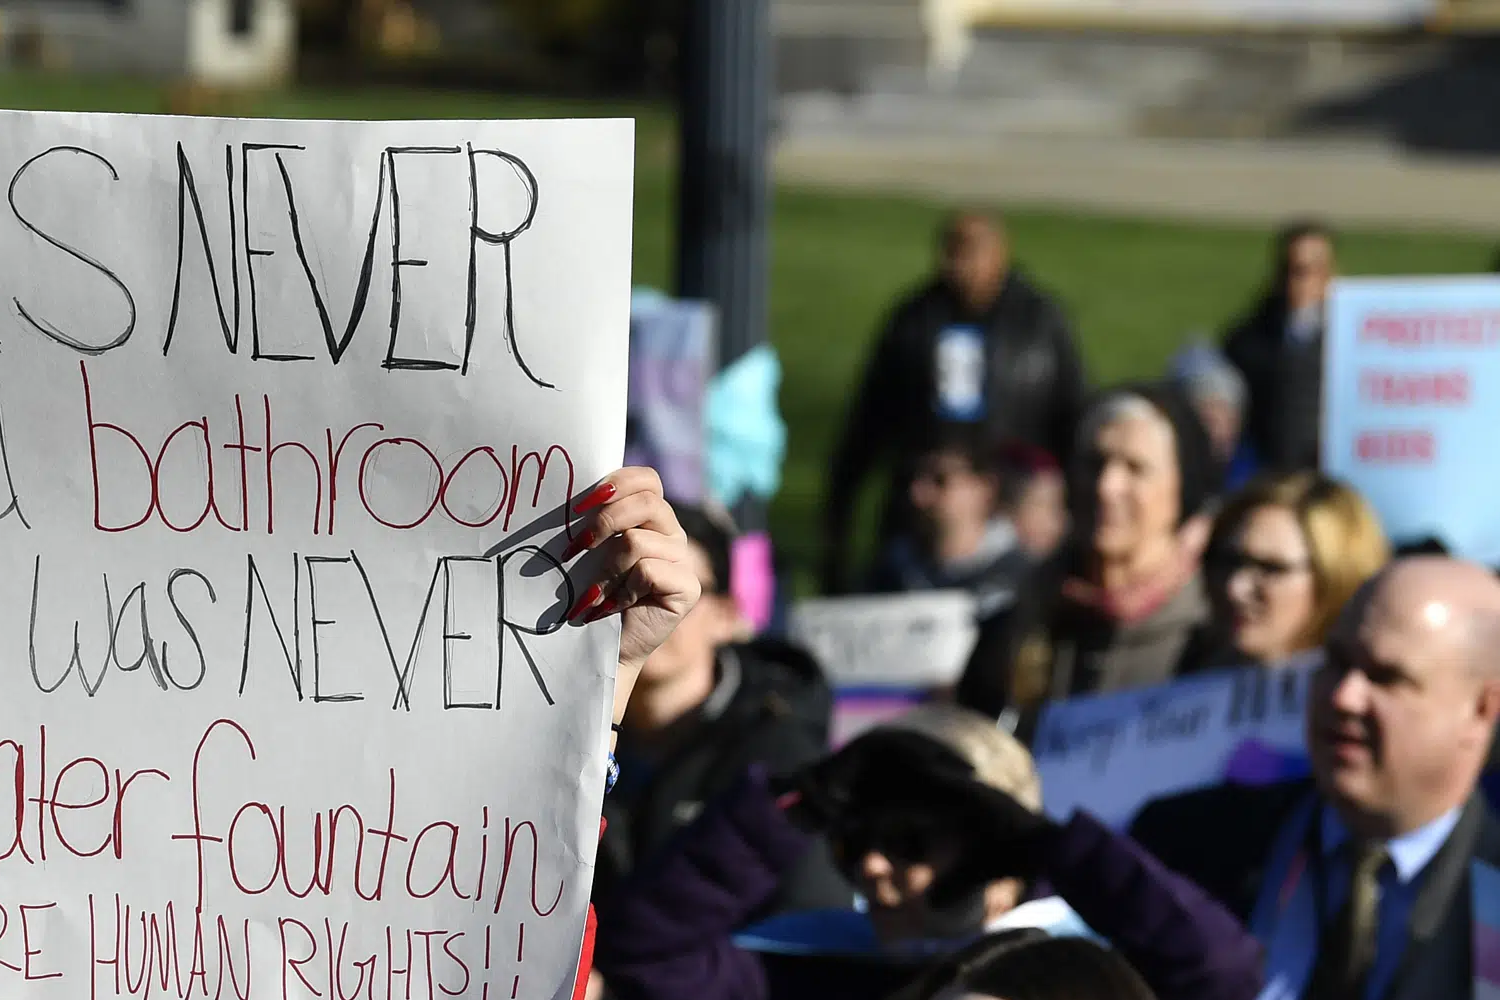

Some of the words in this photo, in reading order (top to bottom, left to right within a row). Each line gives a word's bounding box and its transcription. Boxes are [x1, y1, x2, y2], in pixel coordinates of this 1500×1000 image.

[163, 141, 561, 391] NEVER
[81, 360, 575, 542] bathroom
[239, 547, 574, 711] NEVER
[171, 718, 564, 917] fountain
